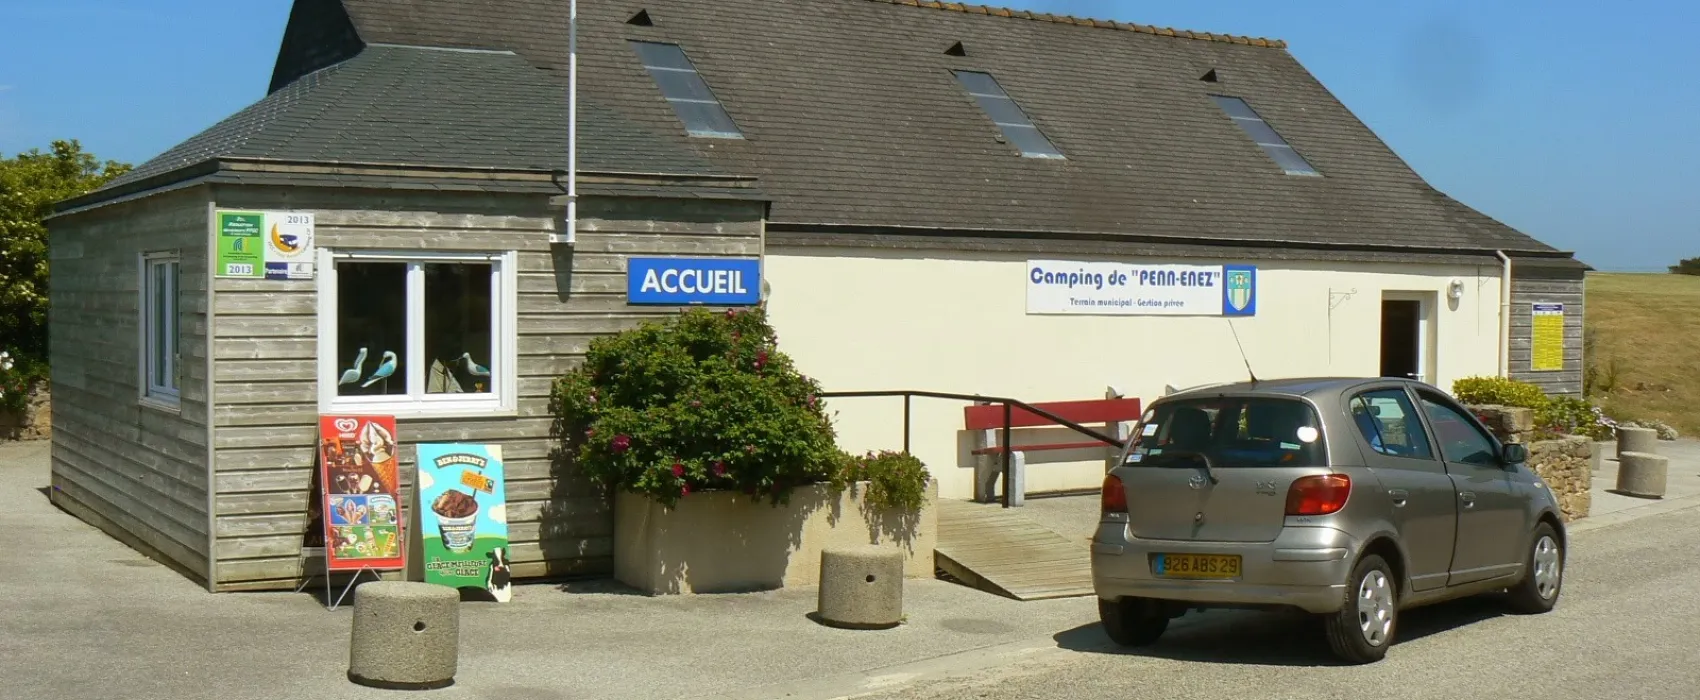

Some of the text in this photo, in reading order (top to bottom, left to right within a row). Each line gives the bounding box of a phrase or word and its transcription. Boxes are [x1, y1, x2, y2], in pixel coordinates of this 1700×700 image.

[287, 215, 309, 224] 2013
[229, 265, 251, 274] 2013
[640, 268, 747, 294] ACCUEIL
[1030, 267, 1103, 290] Camping
[1108, 269, 1127, 286] de
[1070, 297, 1096, 306] Terrain
[1097, 297, 1133, 308] municipal
[1137, 298, 1162, 307] Gestion
[1164, 556, 1237, 573] 926 ABS 29
